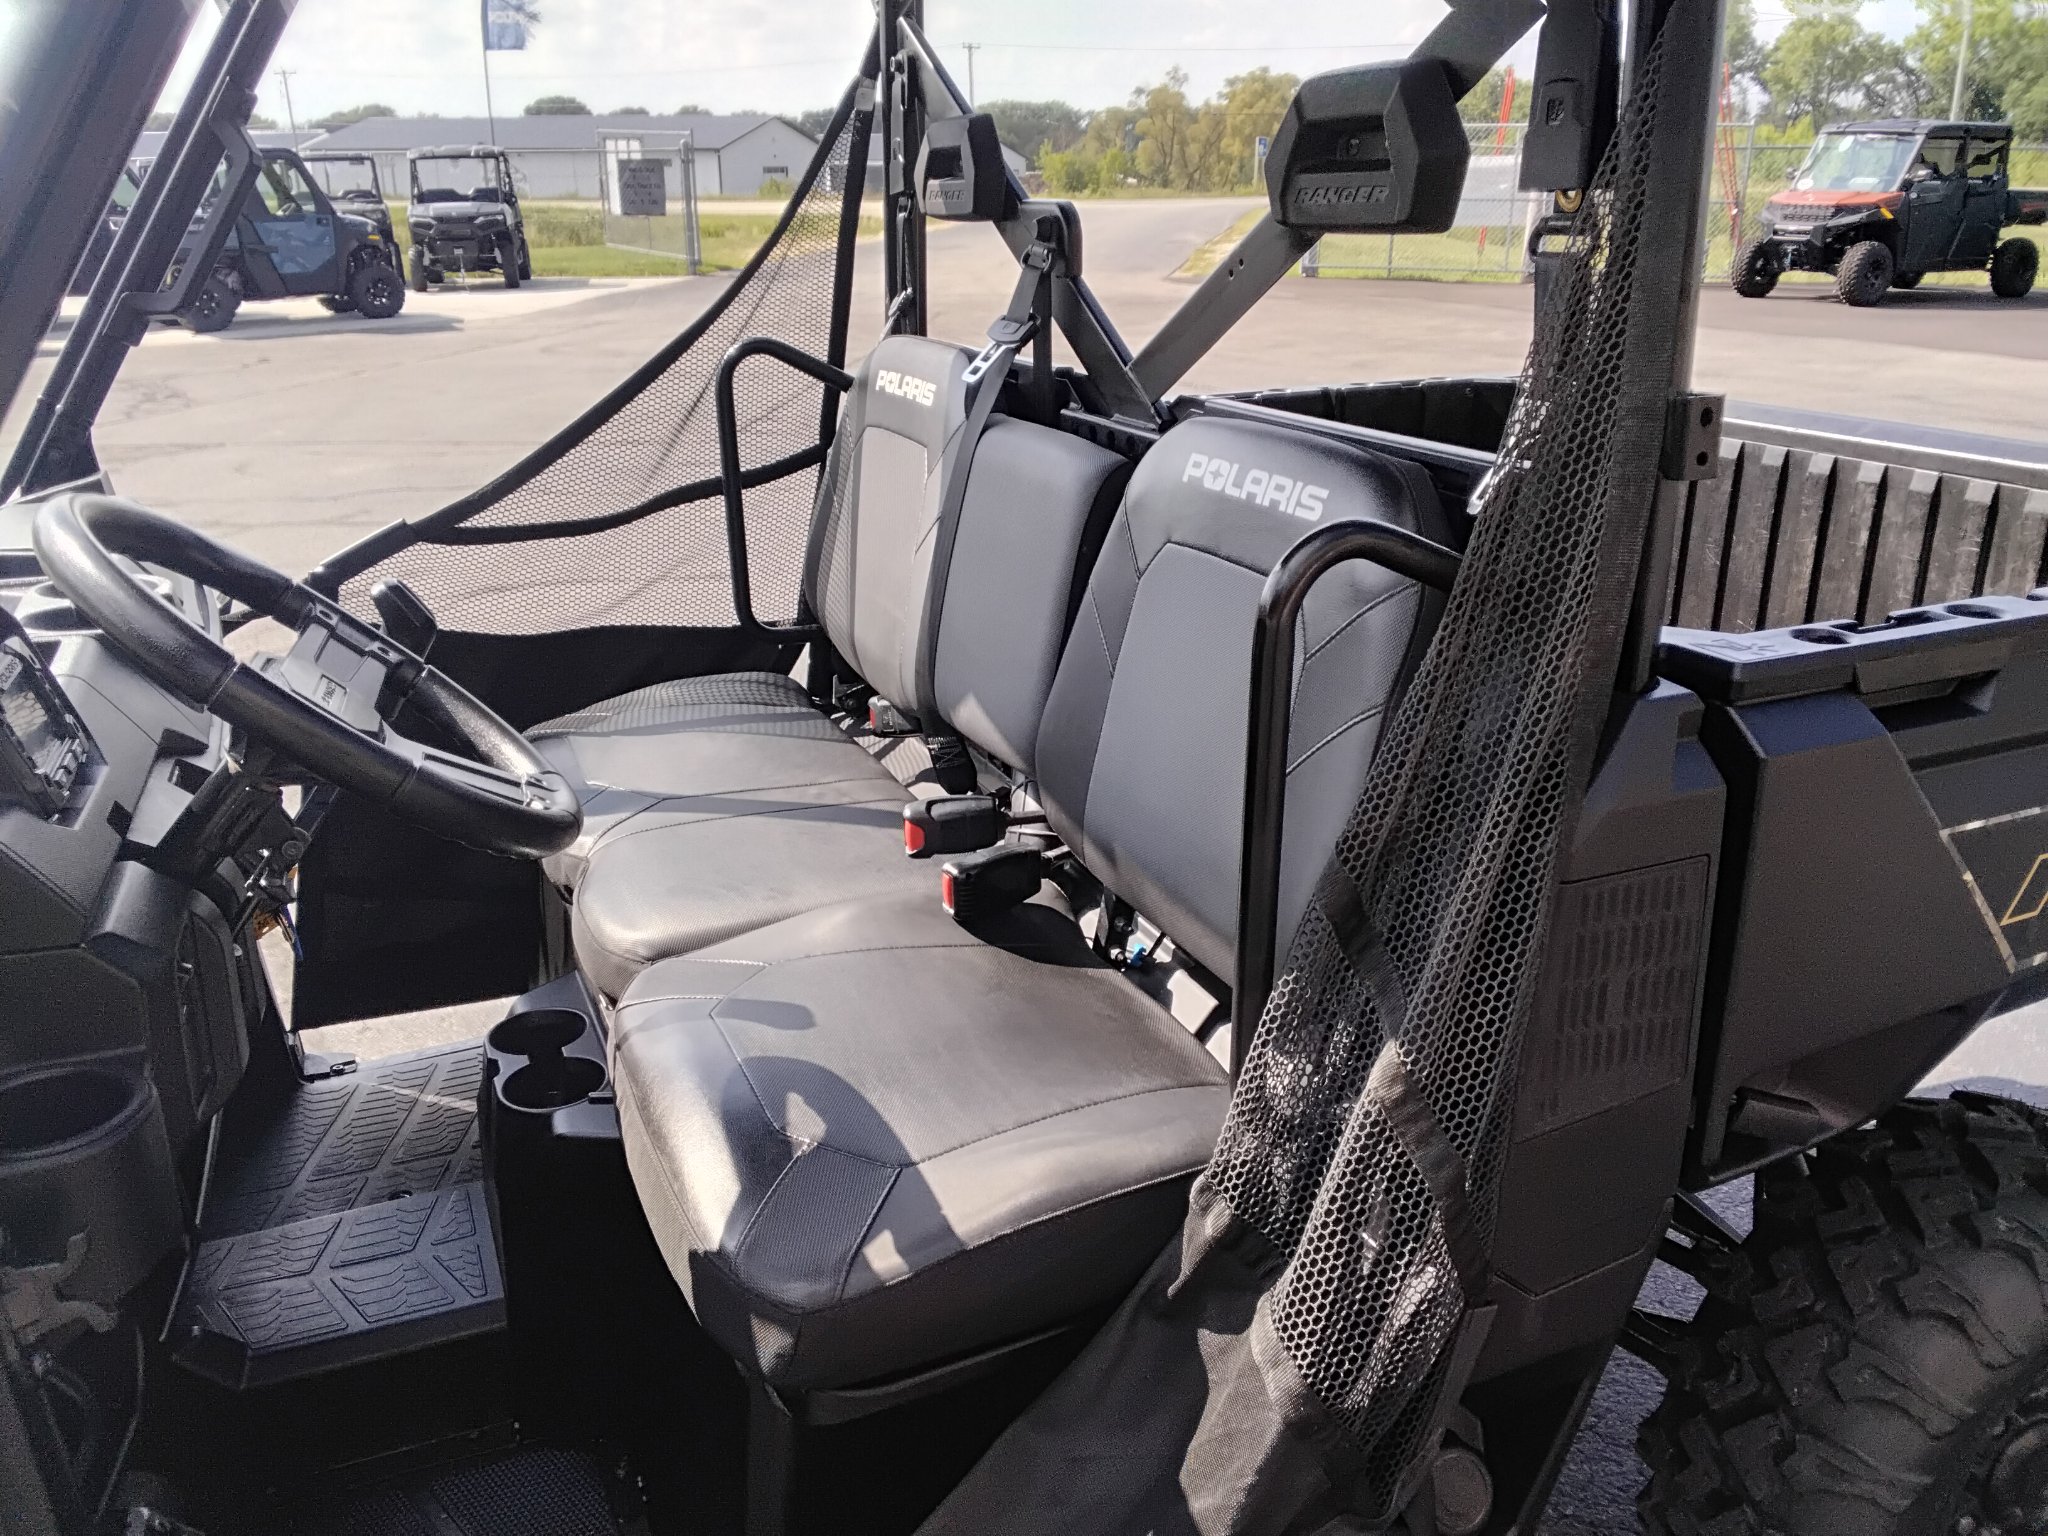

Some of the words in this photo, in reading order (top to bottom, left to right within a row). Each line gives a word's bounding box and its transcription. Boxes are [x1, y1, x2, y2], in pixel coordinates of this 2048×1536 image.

[929, 189, 966, 202] RANGER
[1294, 185, 1390, 203] RANGER
[876, 369, 937, 407] POLARIS
[1182, 452, 1330, 522] POLARIS
